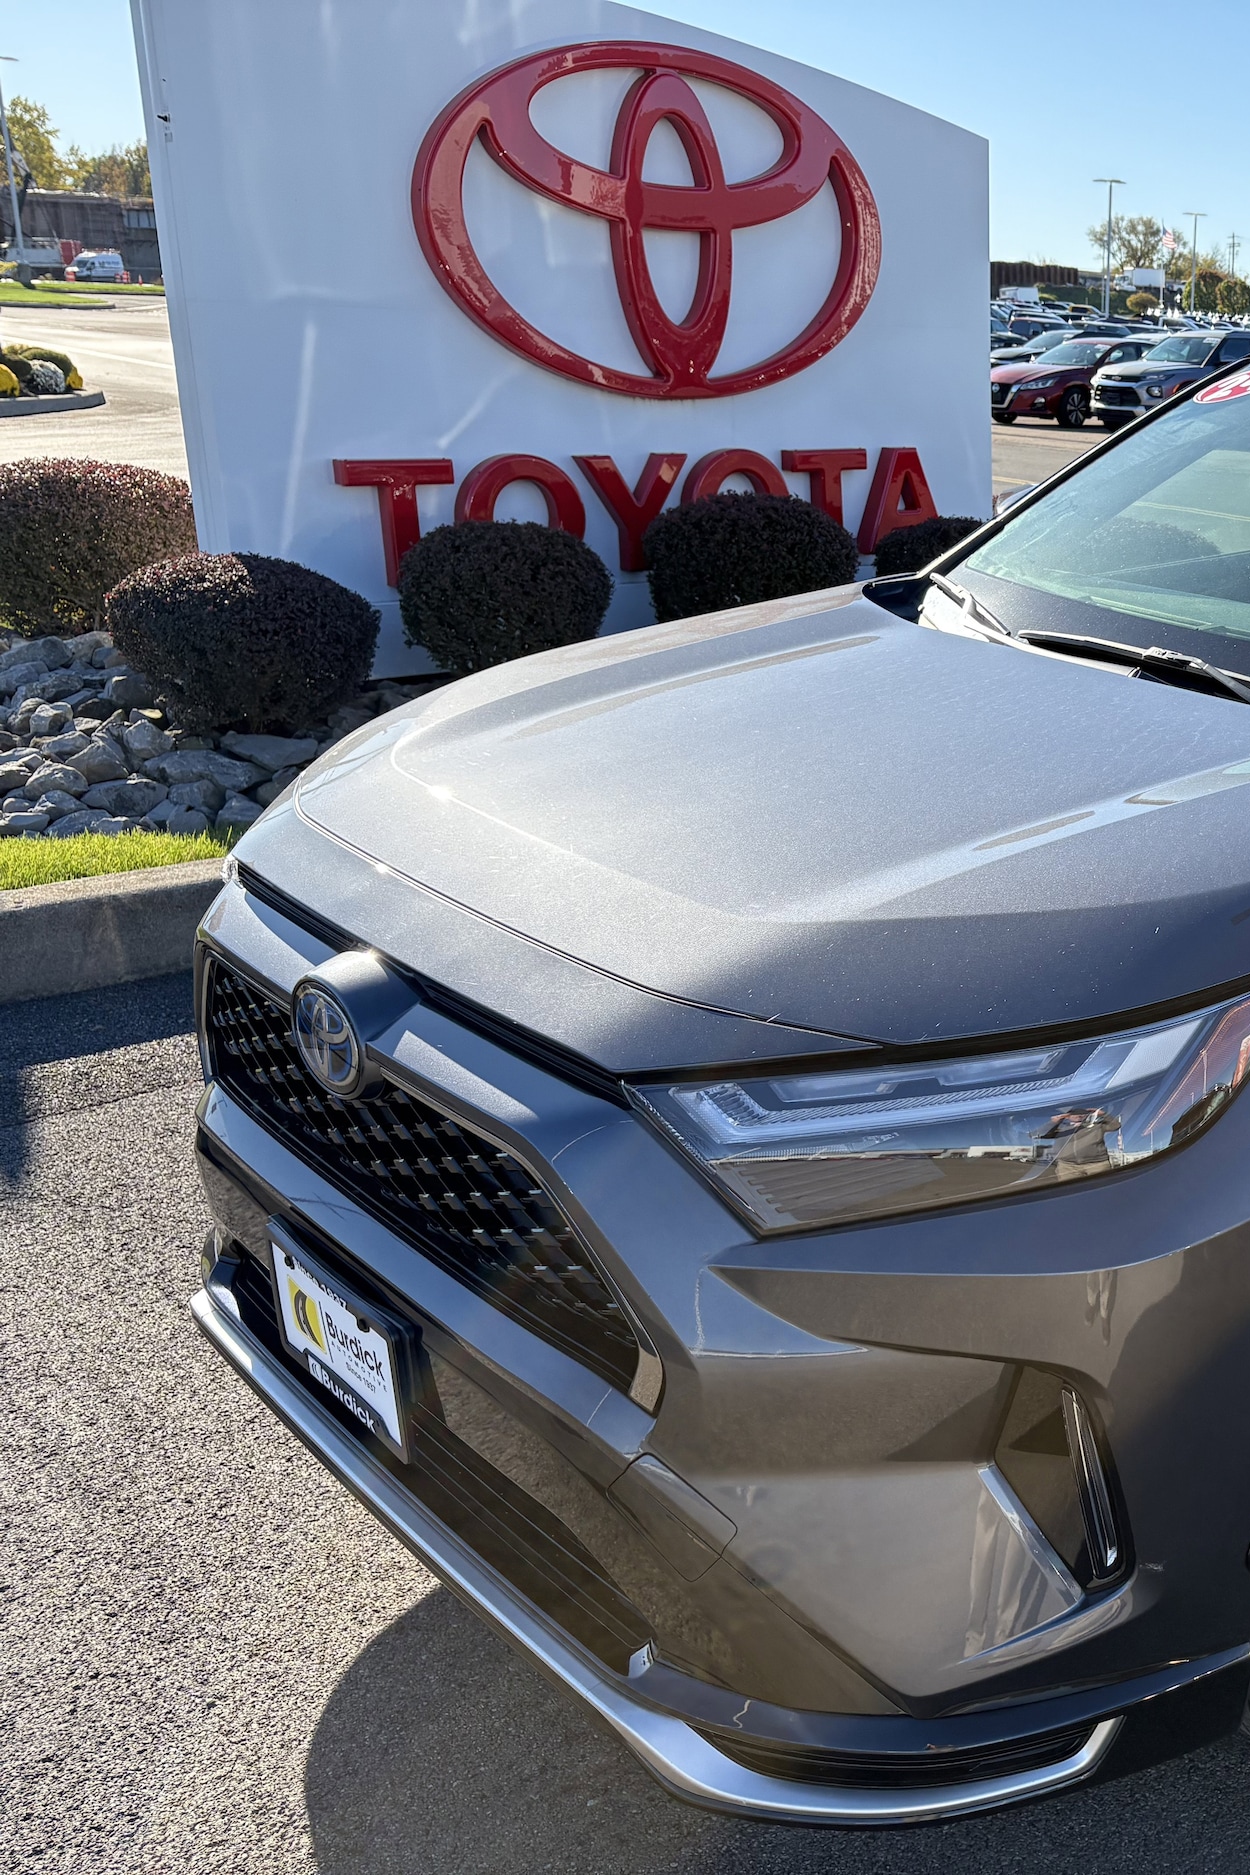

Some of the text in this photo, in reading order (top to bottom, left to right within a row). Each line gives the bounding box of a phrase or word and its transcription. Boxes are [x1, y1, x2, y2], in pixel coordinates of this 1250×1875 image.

[325, 1311, 386, 1383] Burdick
[331, 1340, 388, 1393] AUTOMOTIVE
[321, 1367, 376, 1434] Burdick
